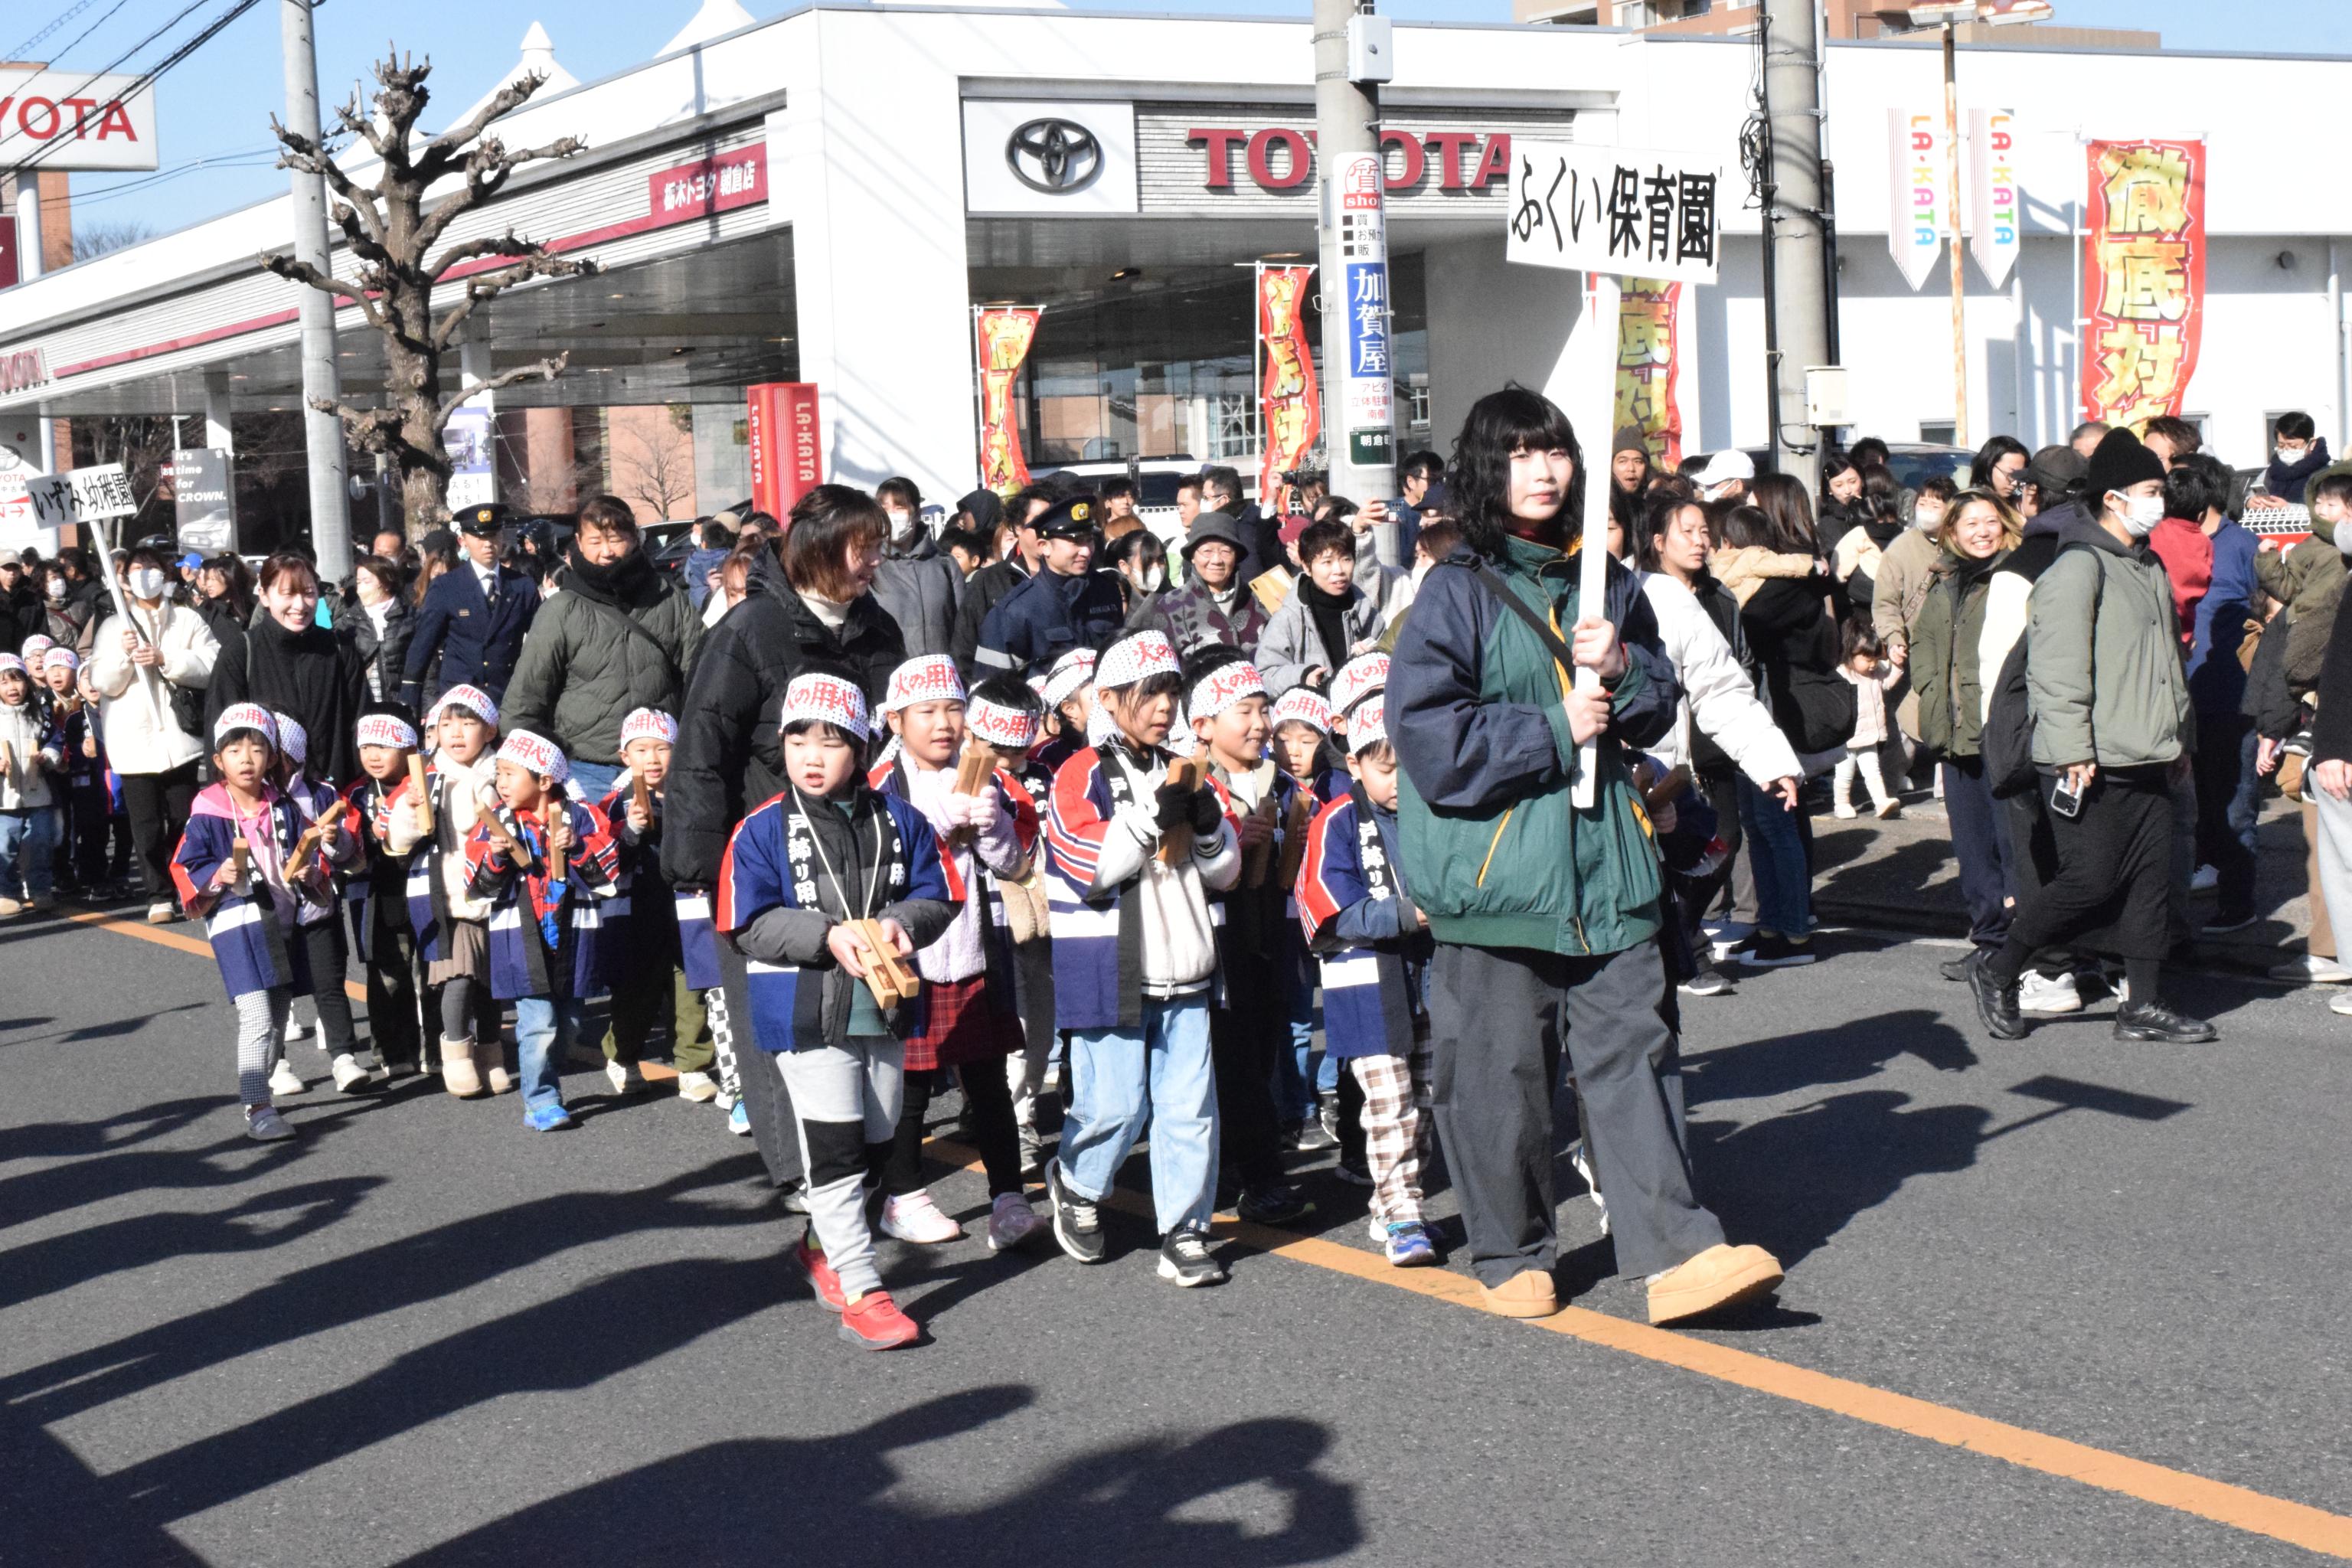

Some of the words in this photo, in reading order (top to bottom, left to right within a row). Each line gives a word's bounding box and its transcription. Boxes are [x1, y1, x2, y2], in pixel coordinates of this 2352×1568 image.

[1187, 128, 1510, 188] TOOTA
[665, 172, 716, 211] 栃木トヨタ
[720, 160, 755, 196] 朝倉店
[1346, 194, 1380, 207] sho
[1354, 268, 1387, 374] 加賀屋
[1351, 396, 1391, 407] 立体駐車
[175, 452, 192, 460] It's
[176, 466, 202, 475] time
[0, 474, 25, 482] OTA
[176, 479, 194, 488] for
[31, 472, 136, 521] いずみ幼稚園
[178, 491, 227, 502] CROWN.
[788, 814, 820, 912] 戸締り用
